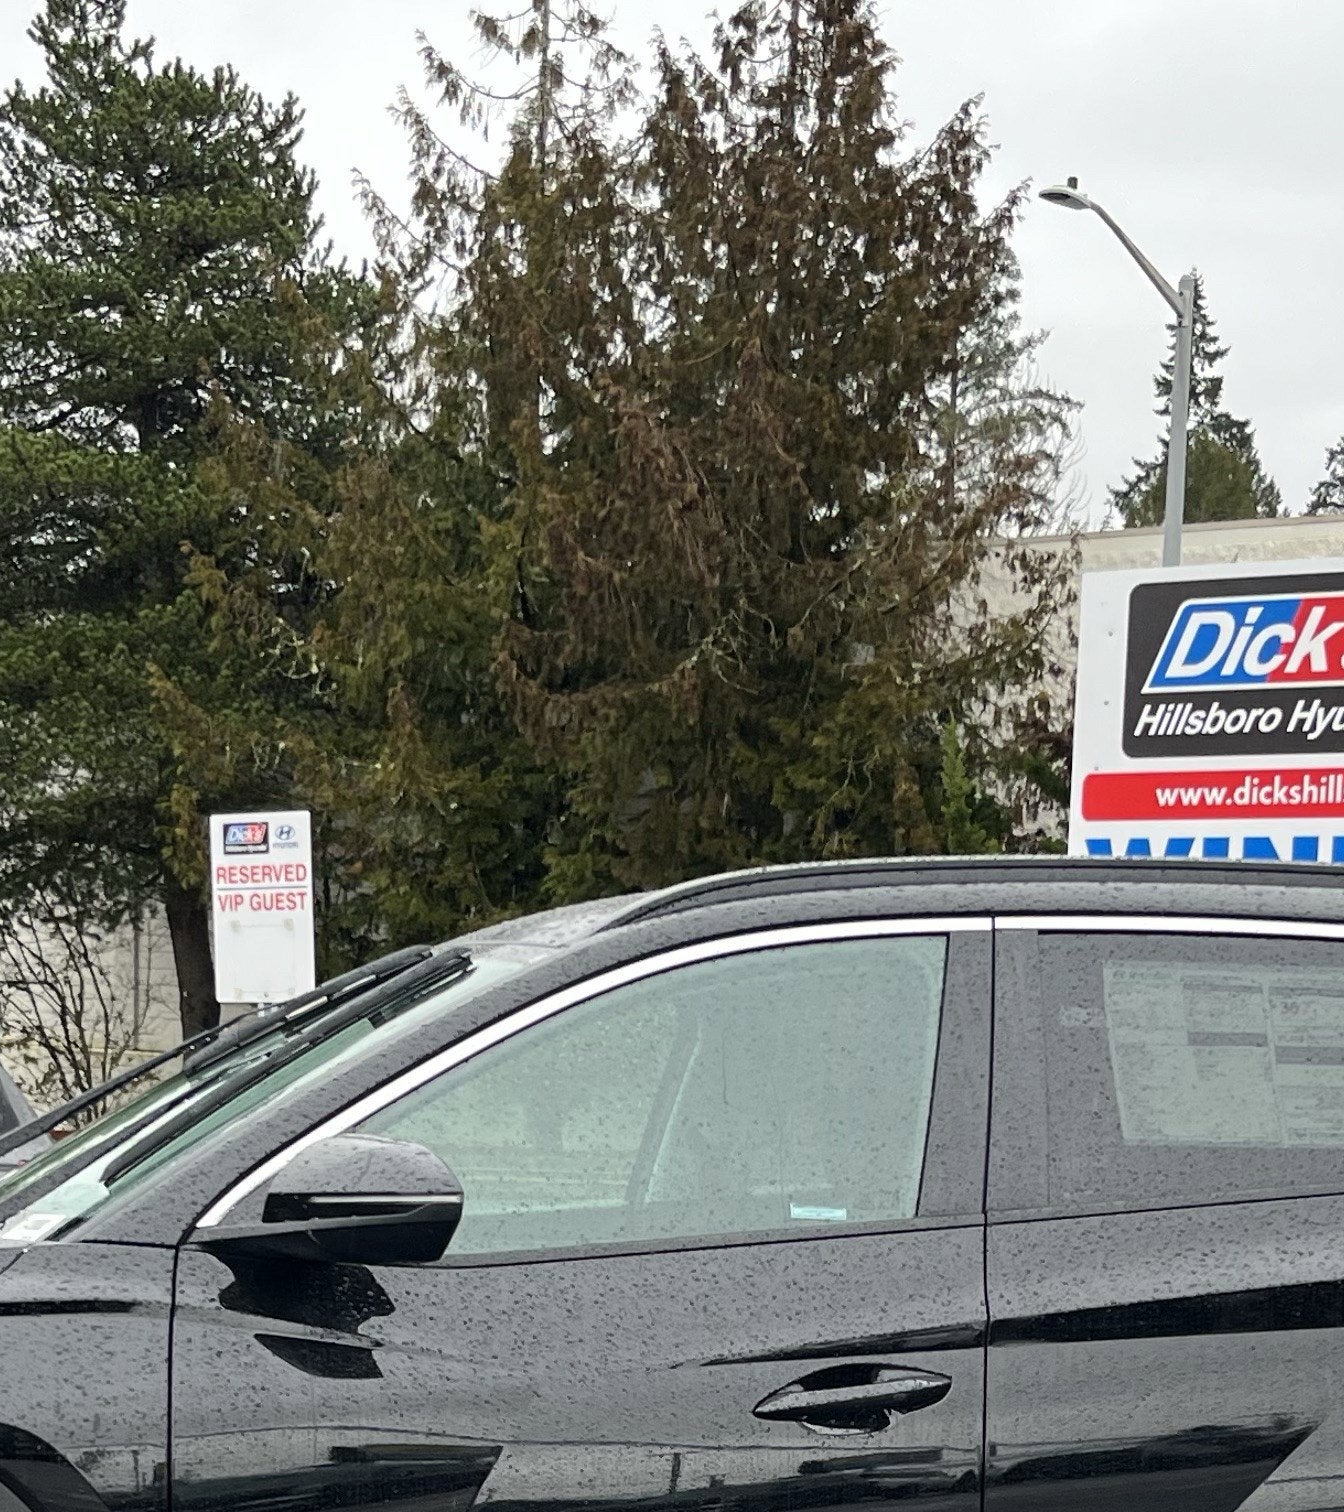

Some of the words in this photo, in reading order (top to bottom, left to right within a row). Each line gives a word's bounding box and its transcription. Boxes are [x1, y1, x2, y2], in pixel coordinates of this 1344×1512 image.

[1133, 701, 1284, 737] Hillsboro
[216, 863, 307, 884] RESERVED
[218, 893, 244, 912] VIP
[250, 892, 307, 911] GUEST
